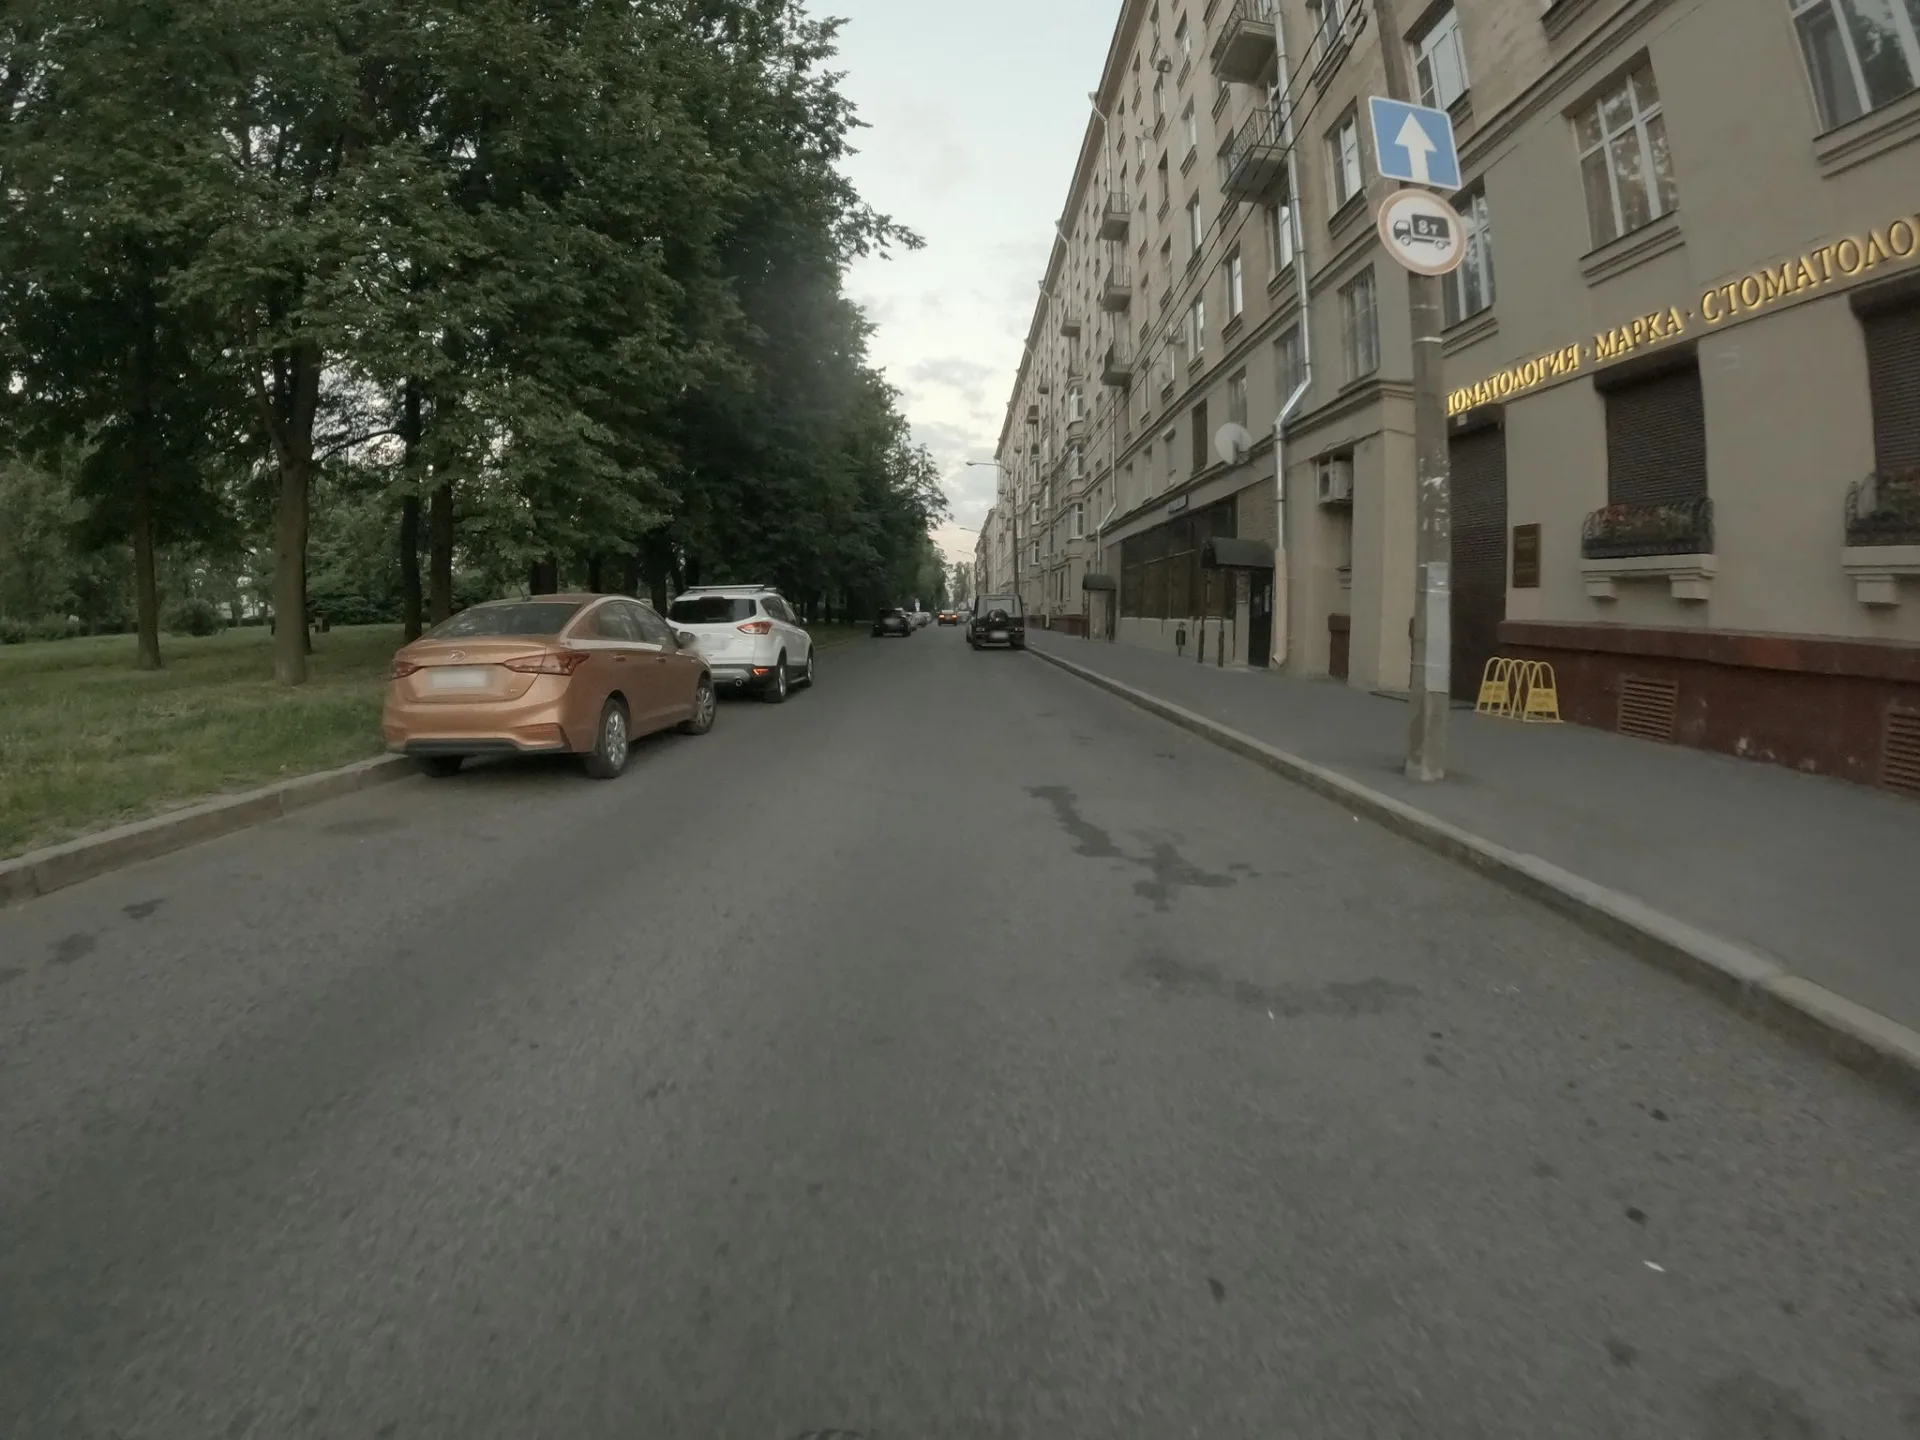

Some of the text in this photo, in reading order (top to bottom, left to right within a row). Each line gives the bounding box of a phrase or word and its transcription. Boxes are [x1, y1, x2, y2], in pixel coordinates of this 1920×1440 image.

[1445, 213, 1920, 416] ТОМАТОЛОГИЯ МАРКА СТОМАТОЛО
